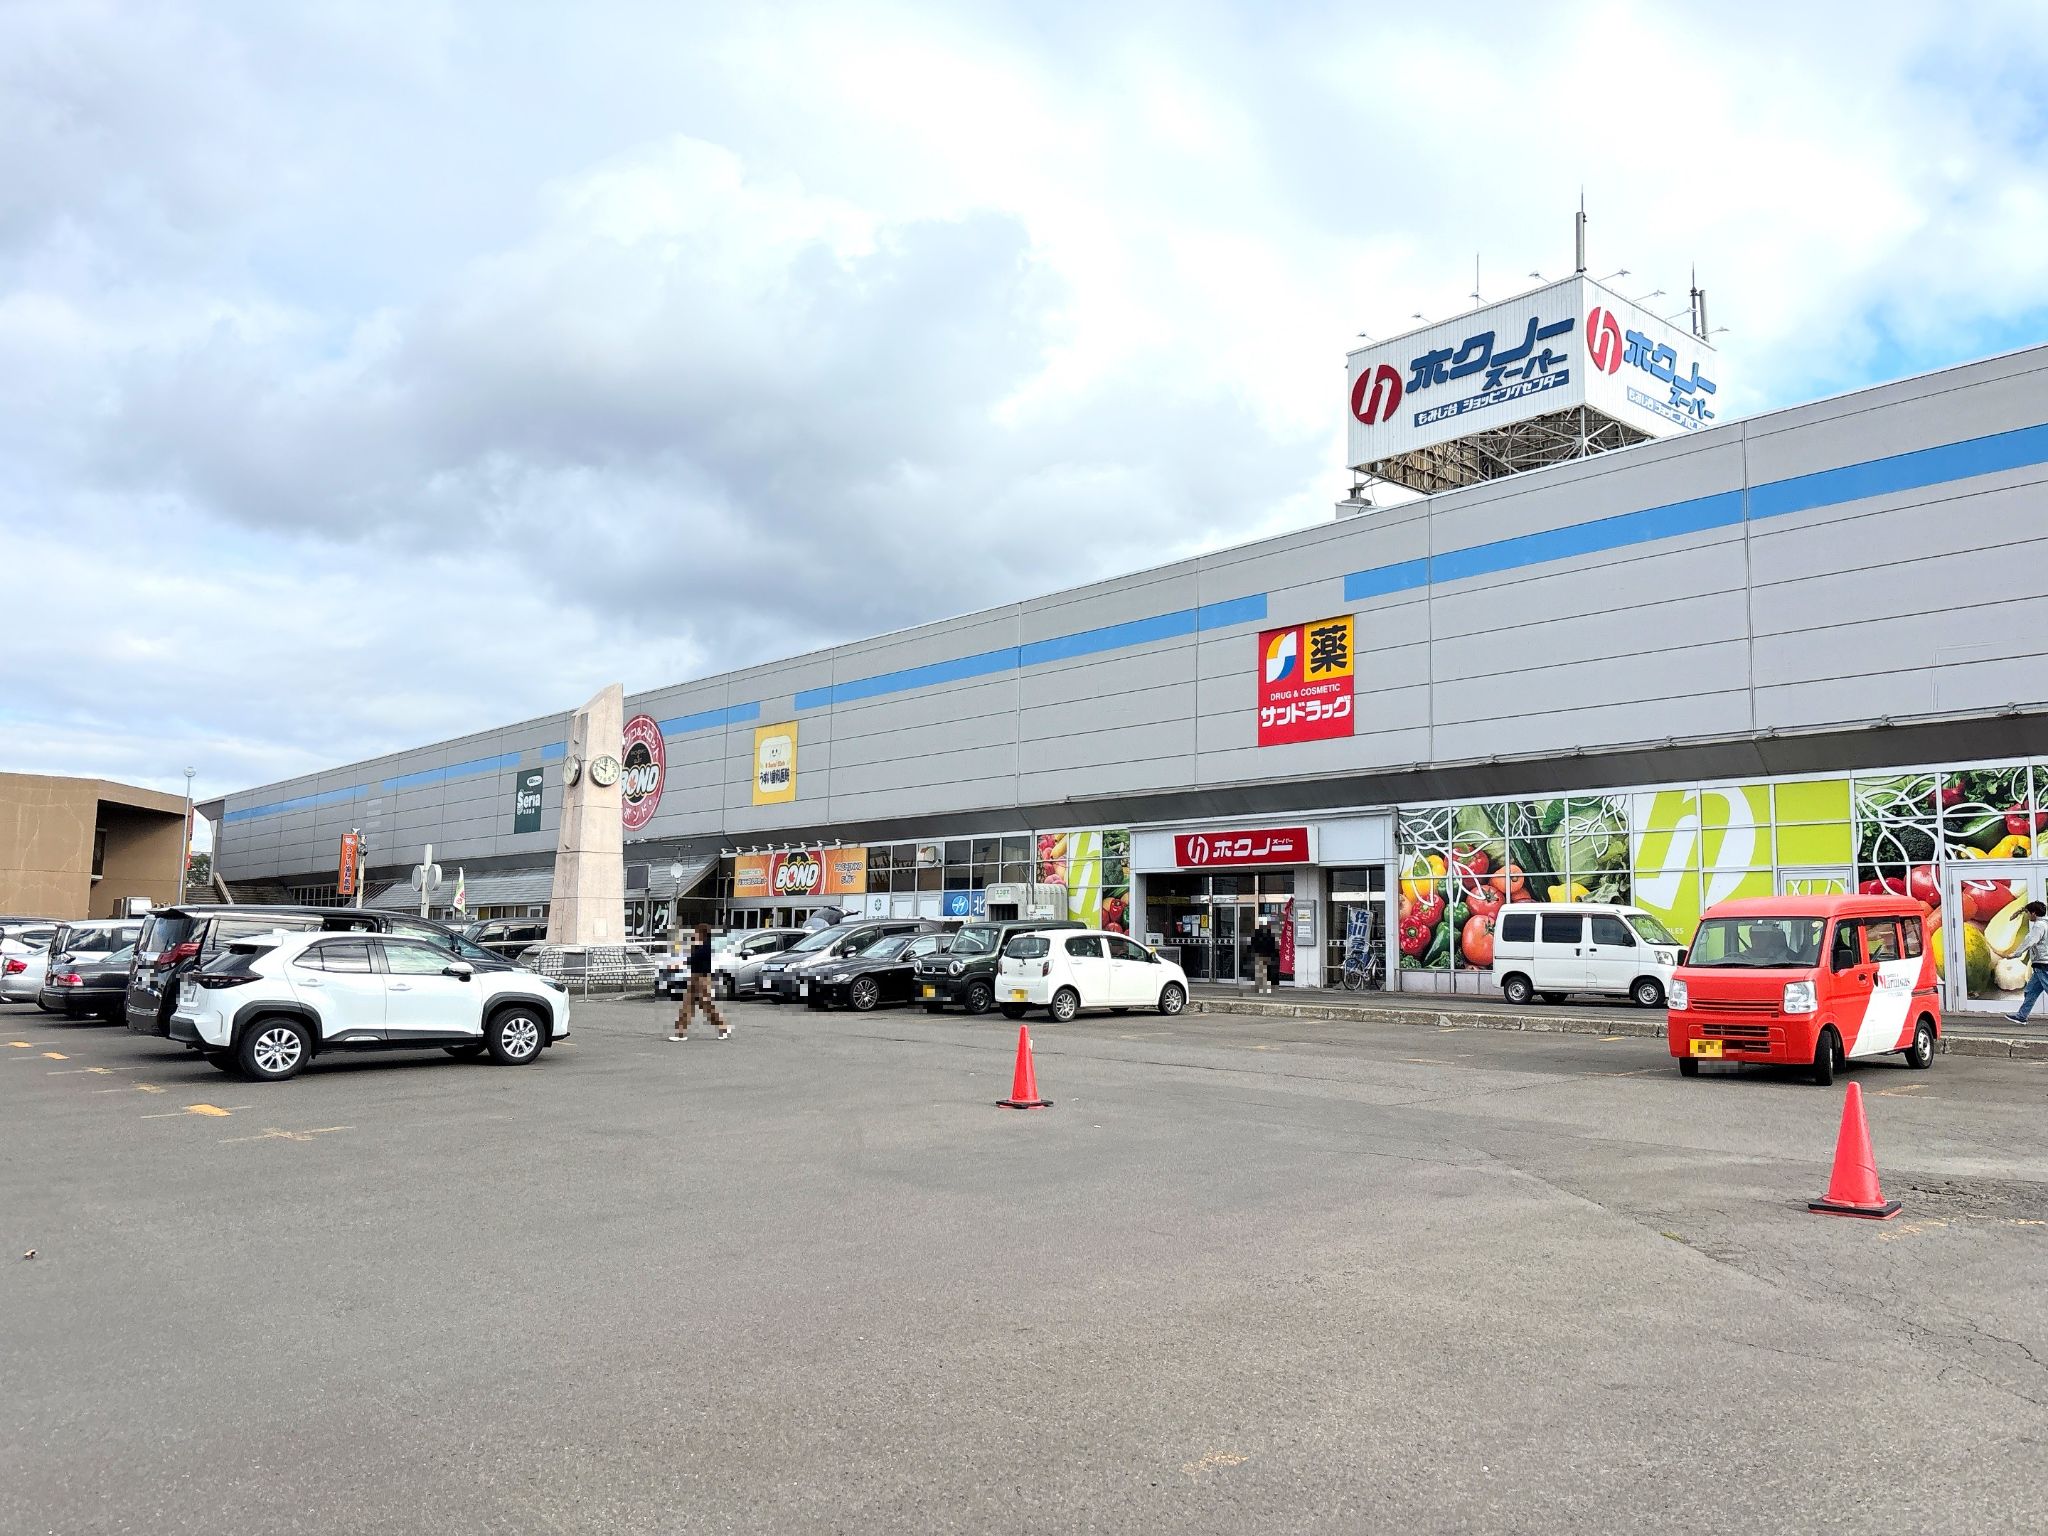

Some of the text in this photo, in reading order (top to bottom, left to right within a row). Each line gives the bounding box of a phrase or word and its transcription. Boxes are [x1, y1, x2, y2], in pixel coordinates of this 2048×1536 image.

[1405, 316, 1575, 393] ホクノー
[1482, 348, 1568, 391] スーパー
[1624, 329, 1717, 395] ホクノー
[1417, 375, 1565, 425] もみじ台 ショッピングセンター
[1668, 386, 1715, 419] スーパー
[1310, 624, 1347, 674] 薬
[1260, 695, 1351, 727] サンドラッグ
[1270, 683, 1341, 701] DRUG & COSMETIC
[1212, 837, 1293, 858] ホクノー
[775, 863, 820, 889] BOND
